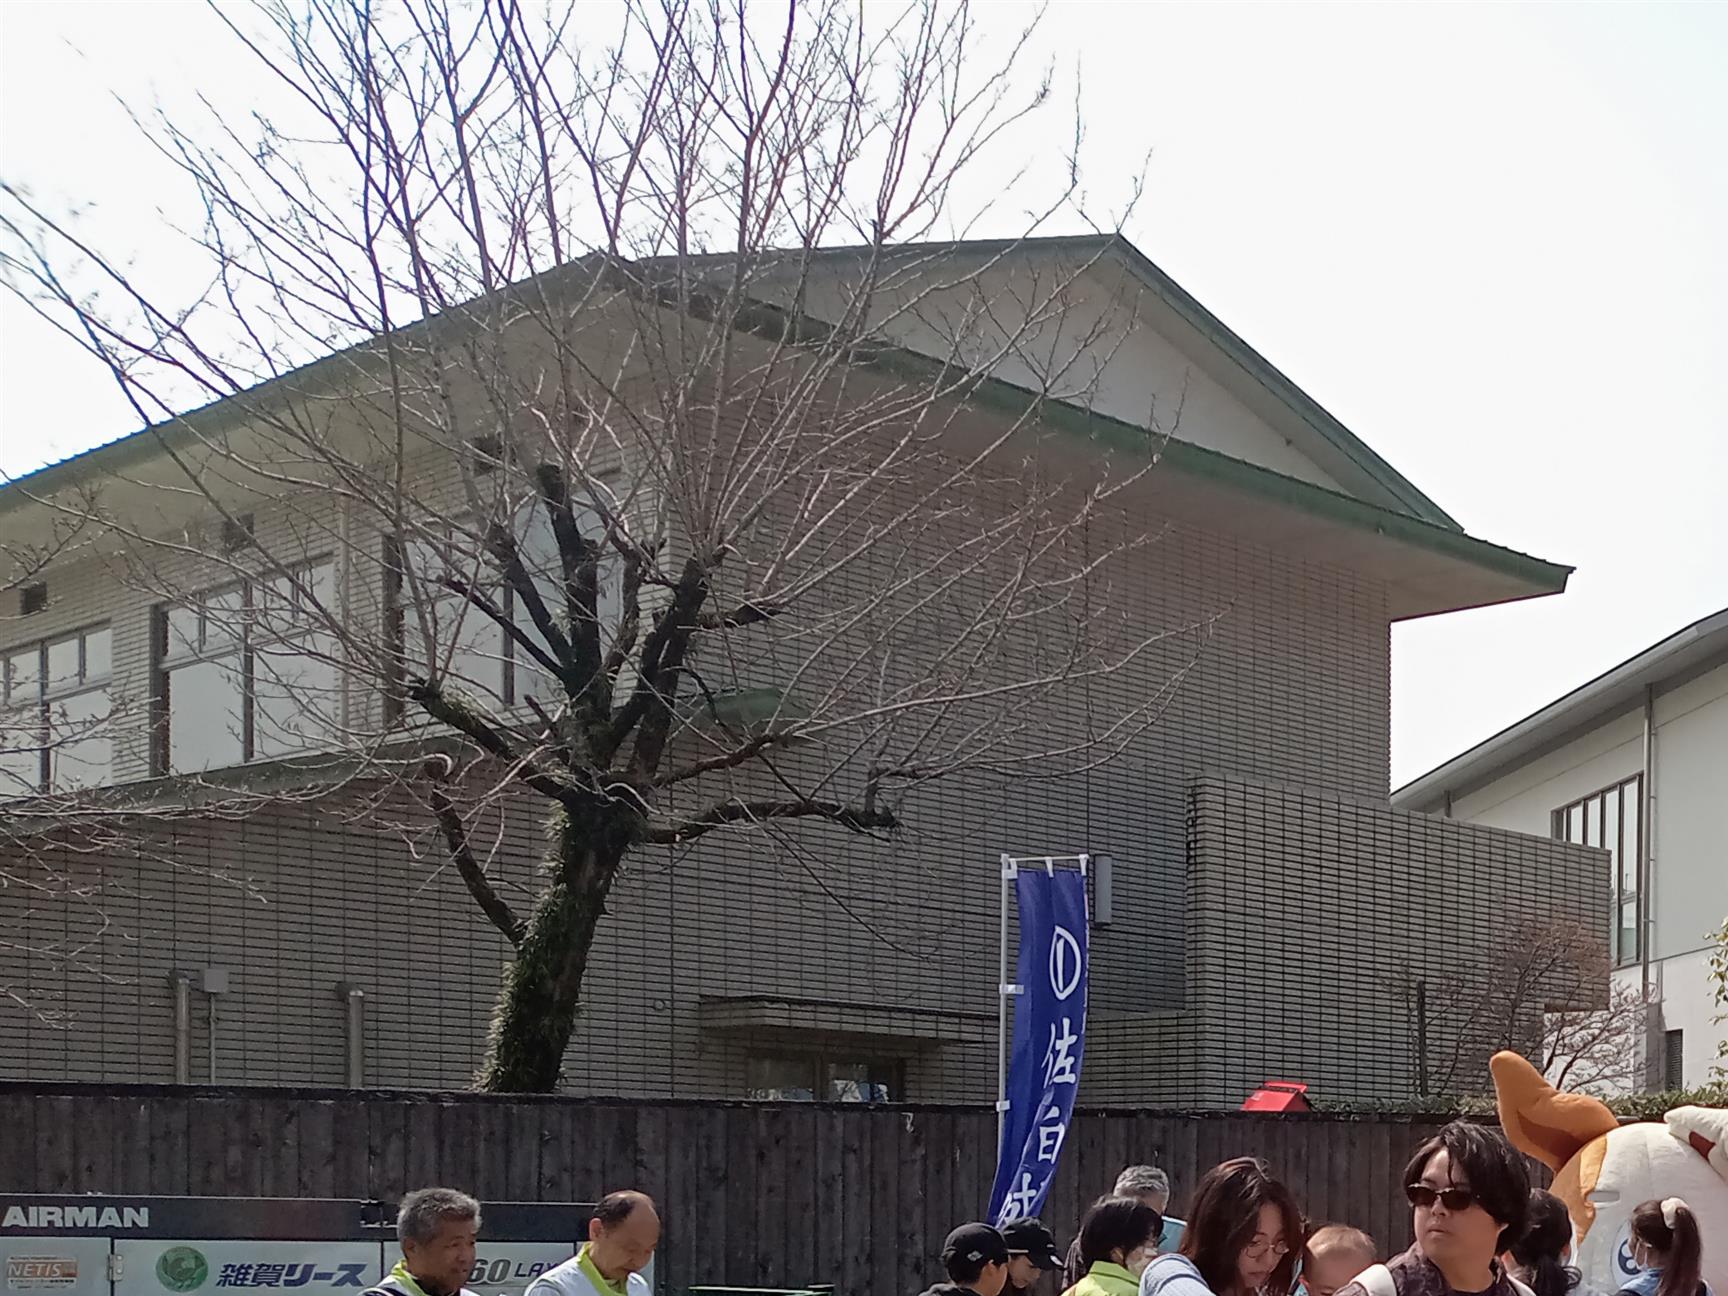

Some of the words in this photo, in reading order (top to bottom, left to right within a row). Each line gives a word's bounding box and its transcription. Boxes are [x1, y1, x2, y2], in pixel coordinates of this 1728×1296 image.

[1, 1205, 149, 1228] AIRMAN
[7, 1262, 62, 1278] NETIS
[216, 1262, 369, 1288] 雑賀リース
